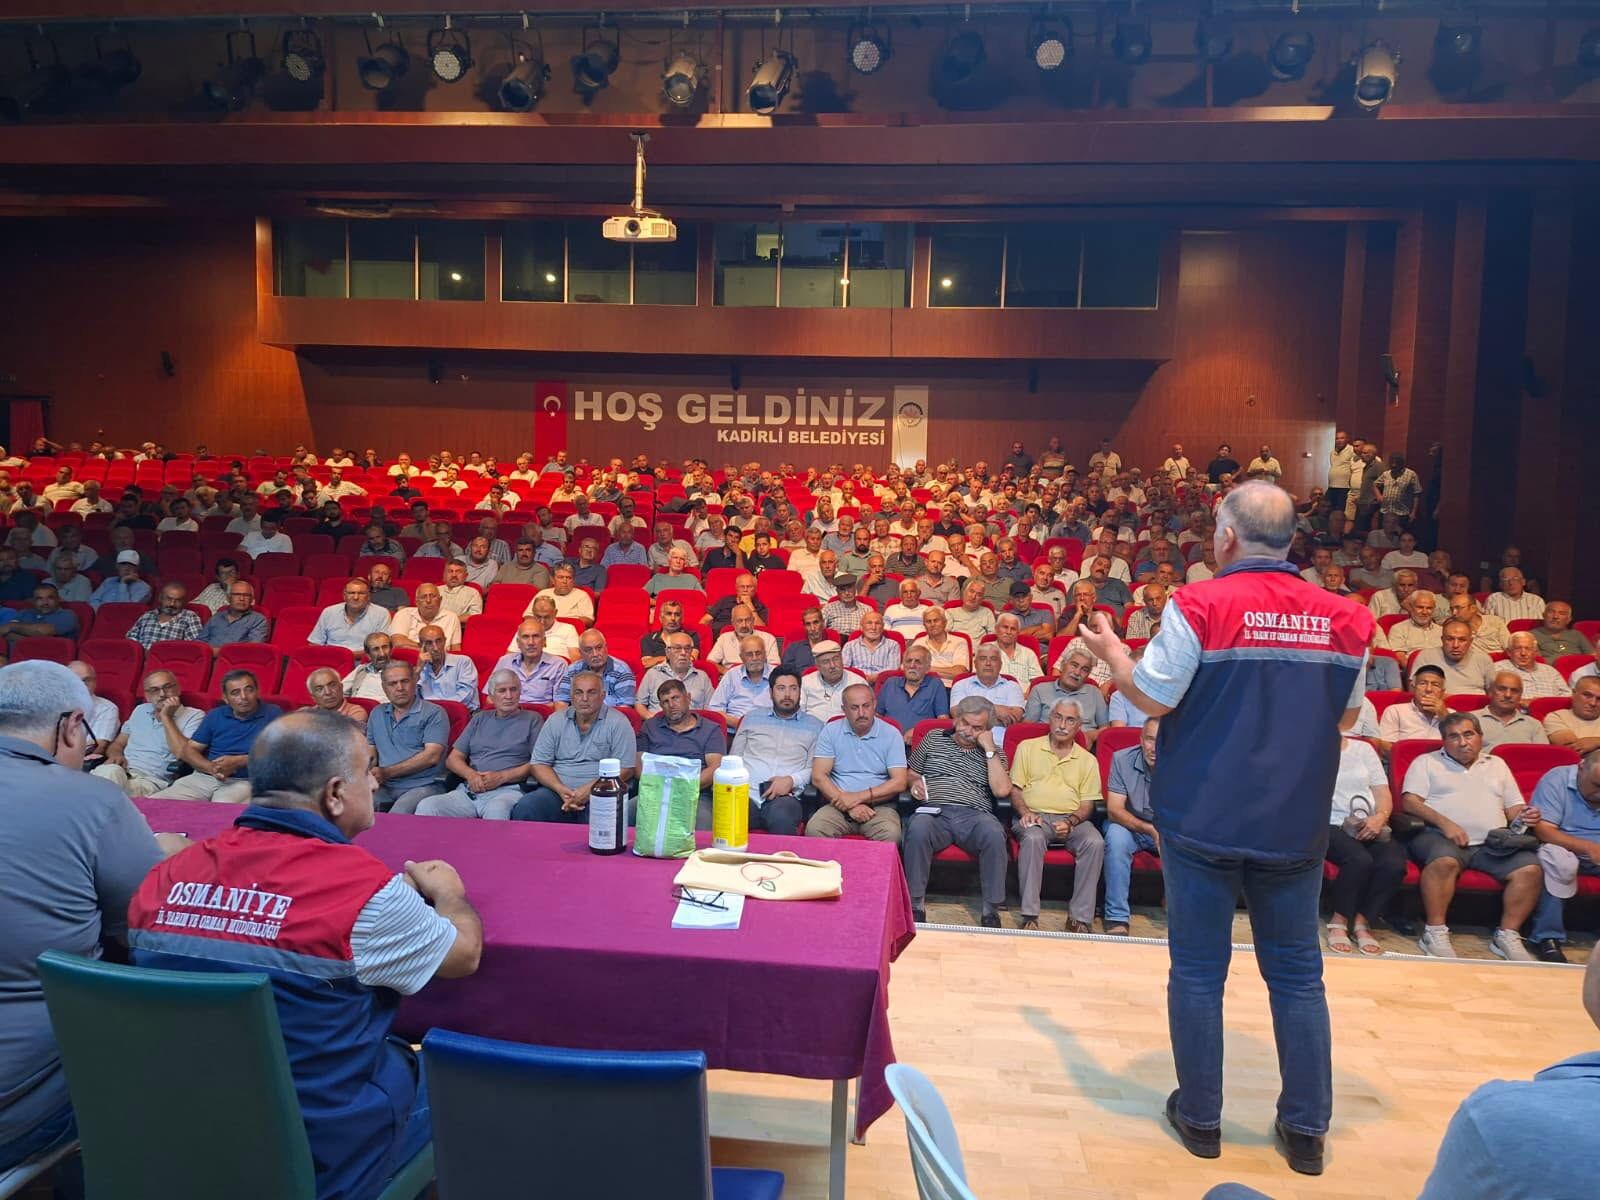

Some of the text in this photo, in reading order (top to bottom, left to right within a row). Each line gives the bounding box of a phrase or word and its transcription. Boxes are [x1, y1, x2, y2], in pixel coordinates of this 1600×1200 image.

[574, 391, 662, 430] HOŞ
[677, 388, 886, 428] GELDİNİZ
[717, 428, 886, 446] KADİRLİ BELEDİYESİ
[1244, 611, 1331, 632] OSMANİYE
[166, 882, 293, 919] OSMANİYE
[198, 915, 229, 932] ORMAN
